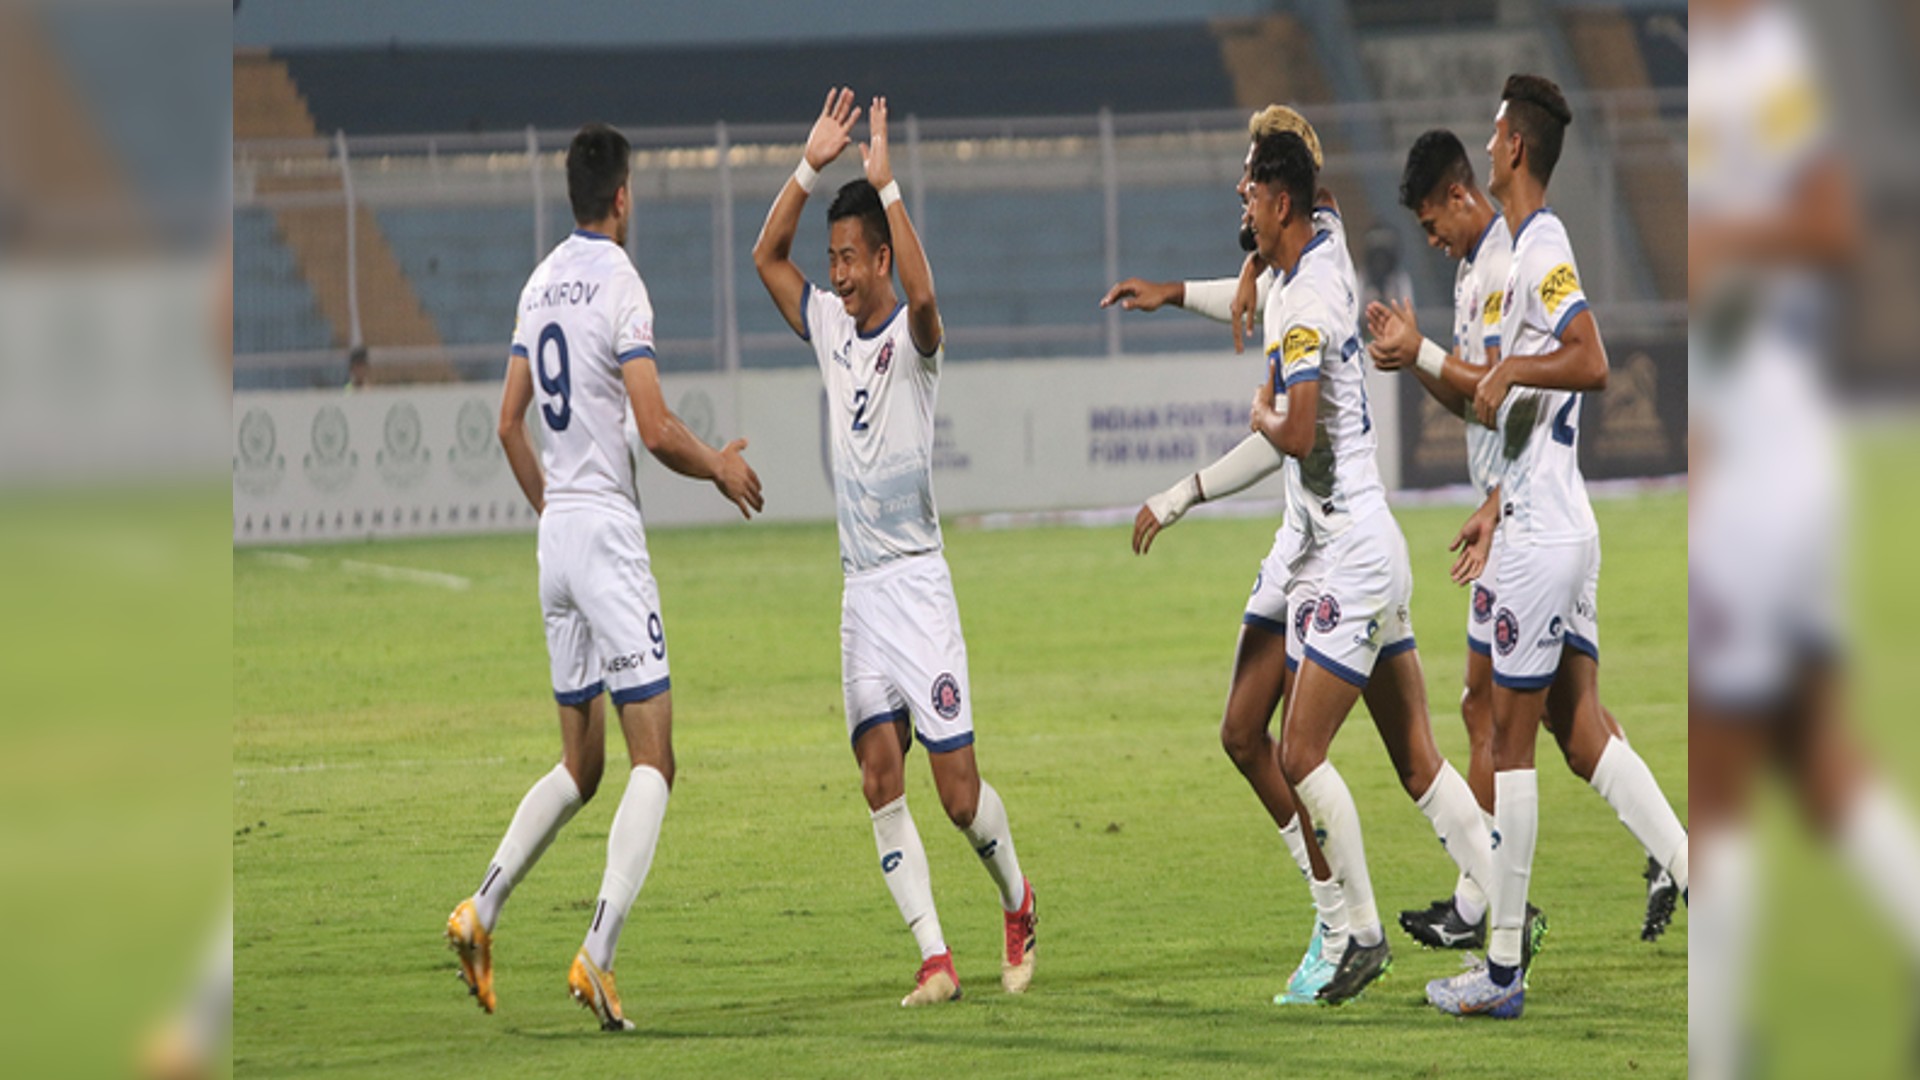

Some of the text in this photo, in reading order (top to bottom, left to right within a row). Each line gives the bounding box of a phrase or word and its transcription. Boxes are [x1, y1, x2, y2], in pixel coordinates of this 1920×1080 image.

[537, 321, 571, 432] 9
[851, 388, 870, 431] 2
[647, 612, 665, 660] 9
